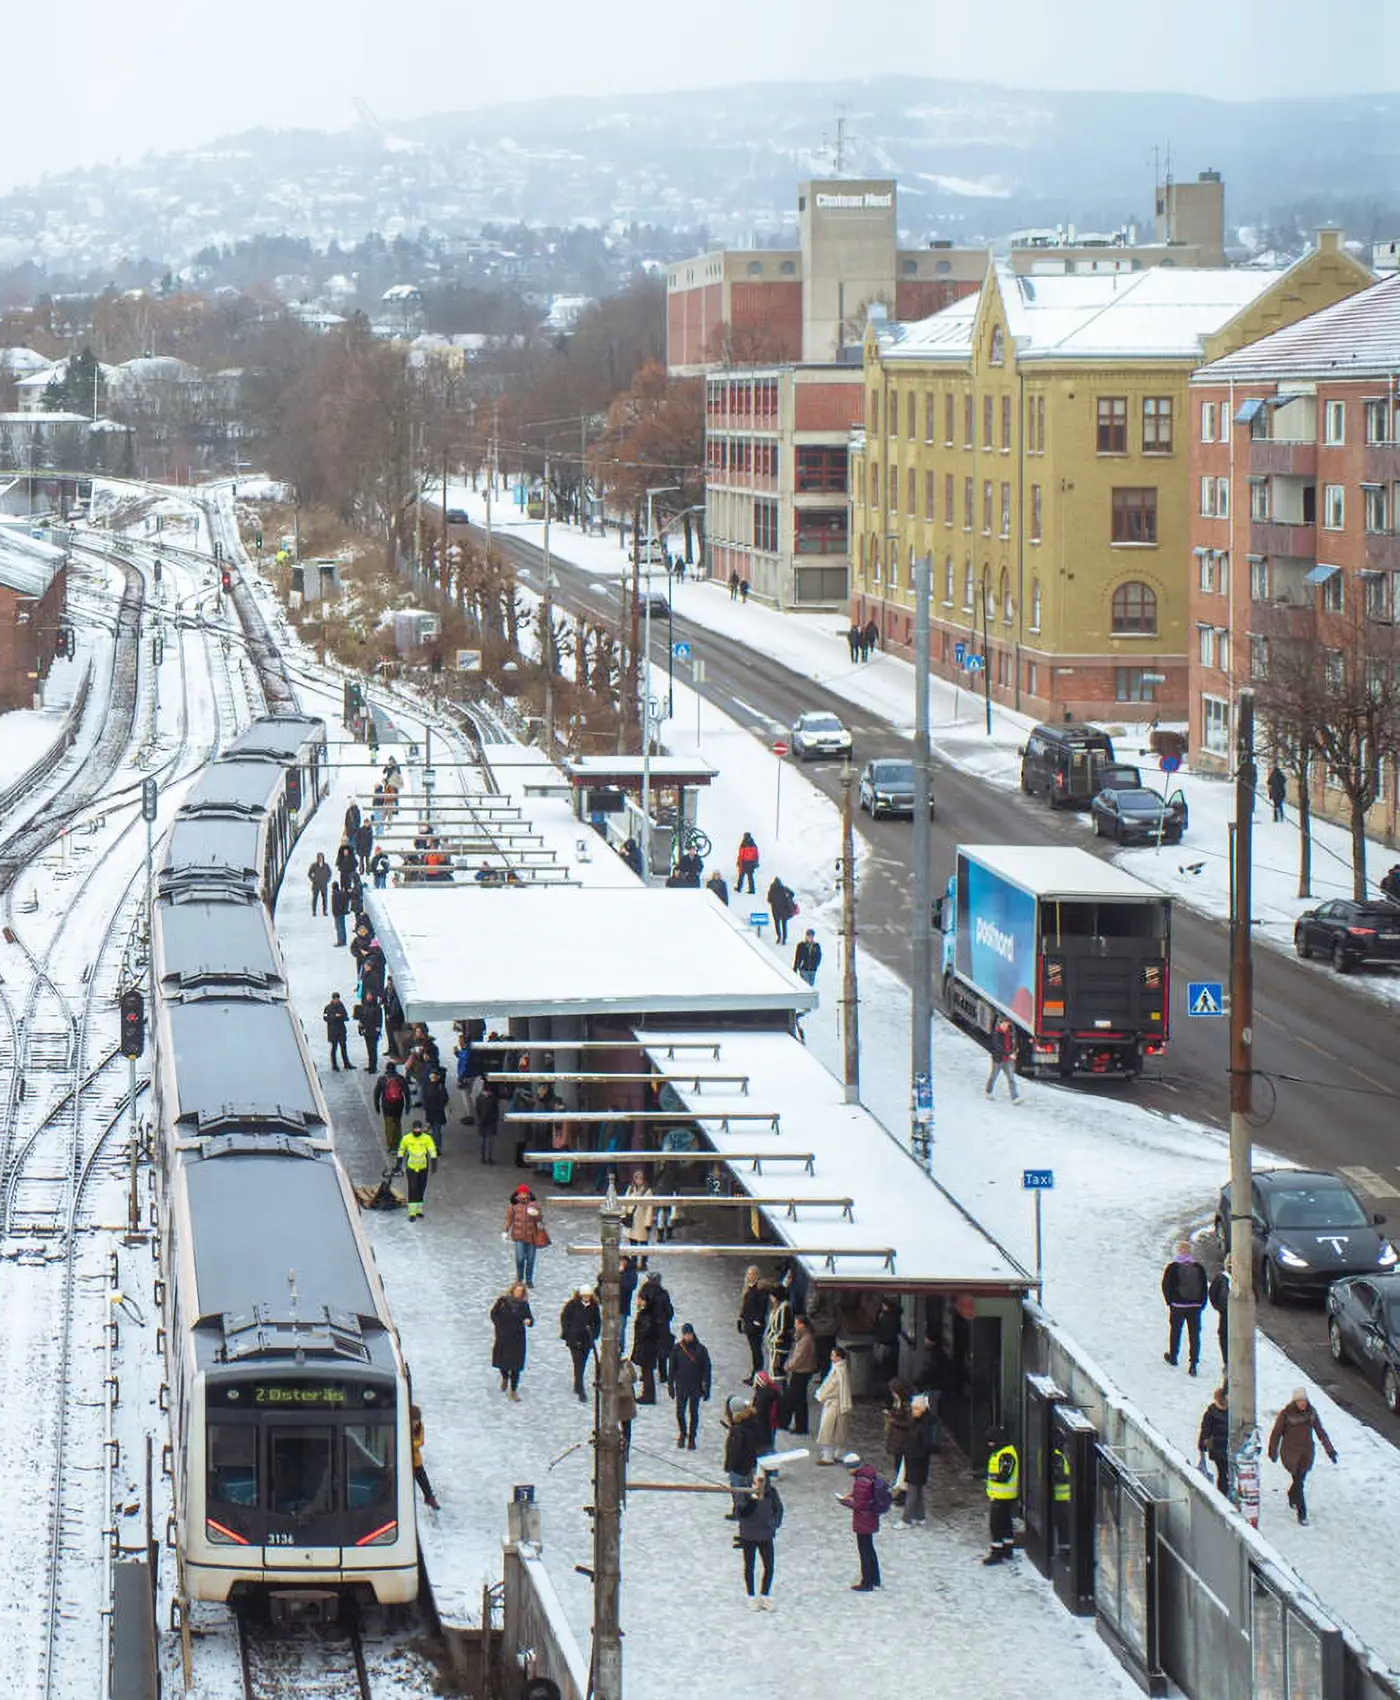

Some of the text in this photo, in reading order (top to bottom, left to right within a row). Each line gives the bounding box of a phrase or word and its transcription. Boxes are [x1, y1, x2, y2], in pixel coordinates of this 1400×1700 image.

[816, 193, 863, 207] Chateau
[975, 917, 1014, 963] postnord
[1025, 1173, 1053, 1185] Taxi
[255, 1388, 265, 1402] 2
